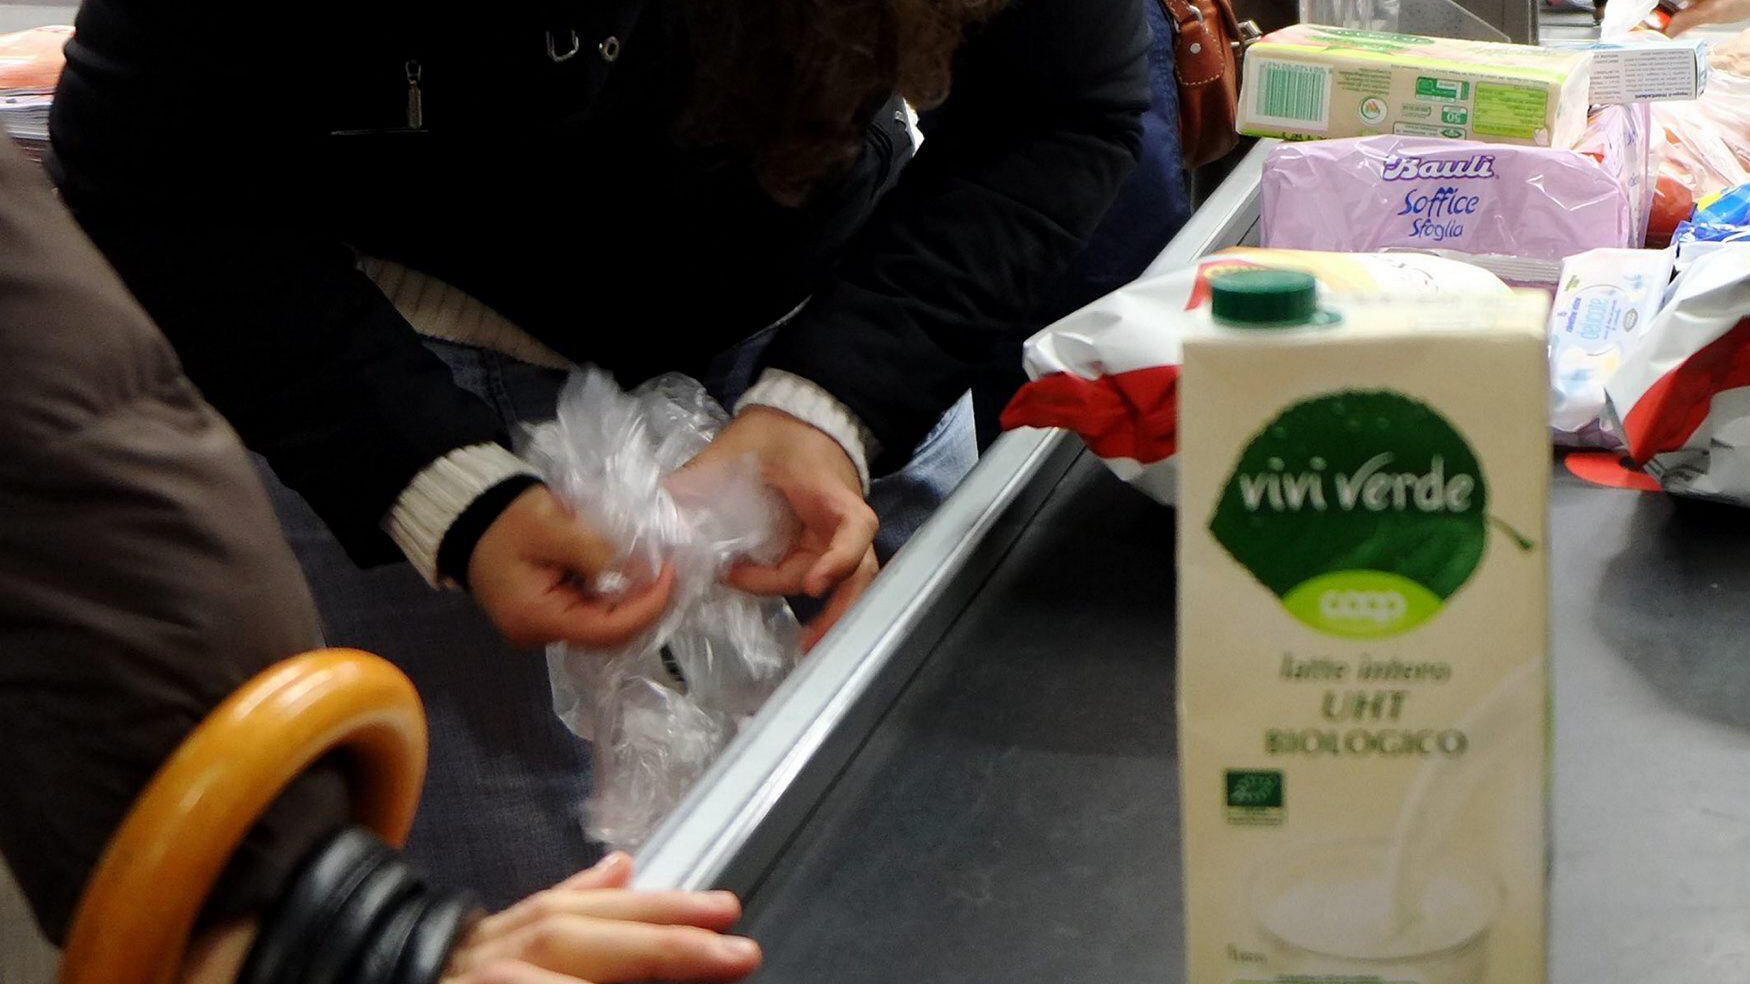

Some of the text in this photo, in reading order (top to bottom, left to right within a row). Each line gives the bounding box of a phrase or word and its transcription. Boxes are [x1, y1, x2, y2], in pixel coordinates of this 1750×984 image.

[1383, 155, 1495, 181] Bauli
[1397, 187, 1479, 217] Soffice
[1409, 218, 1464, 241] Sfoglia
[1239, 451, 1475, 513] vivi verde
[1280, 651, 1452, 681] latte intero
[1322, 690, 1409, 722] UHT
[1265, 729, 1469, 757] BIOLOGICO
